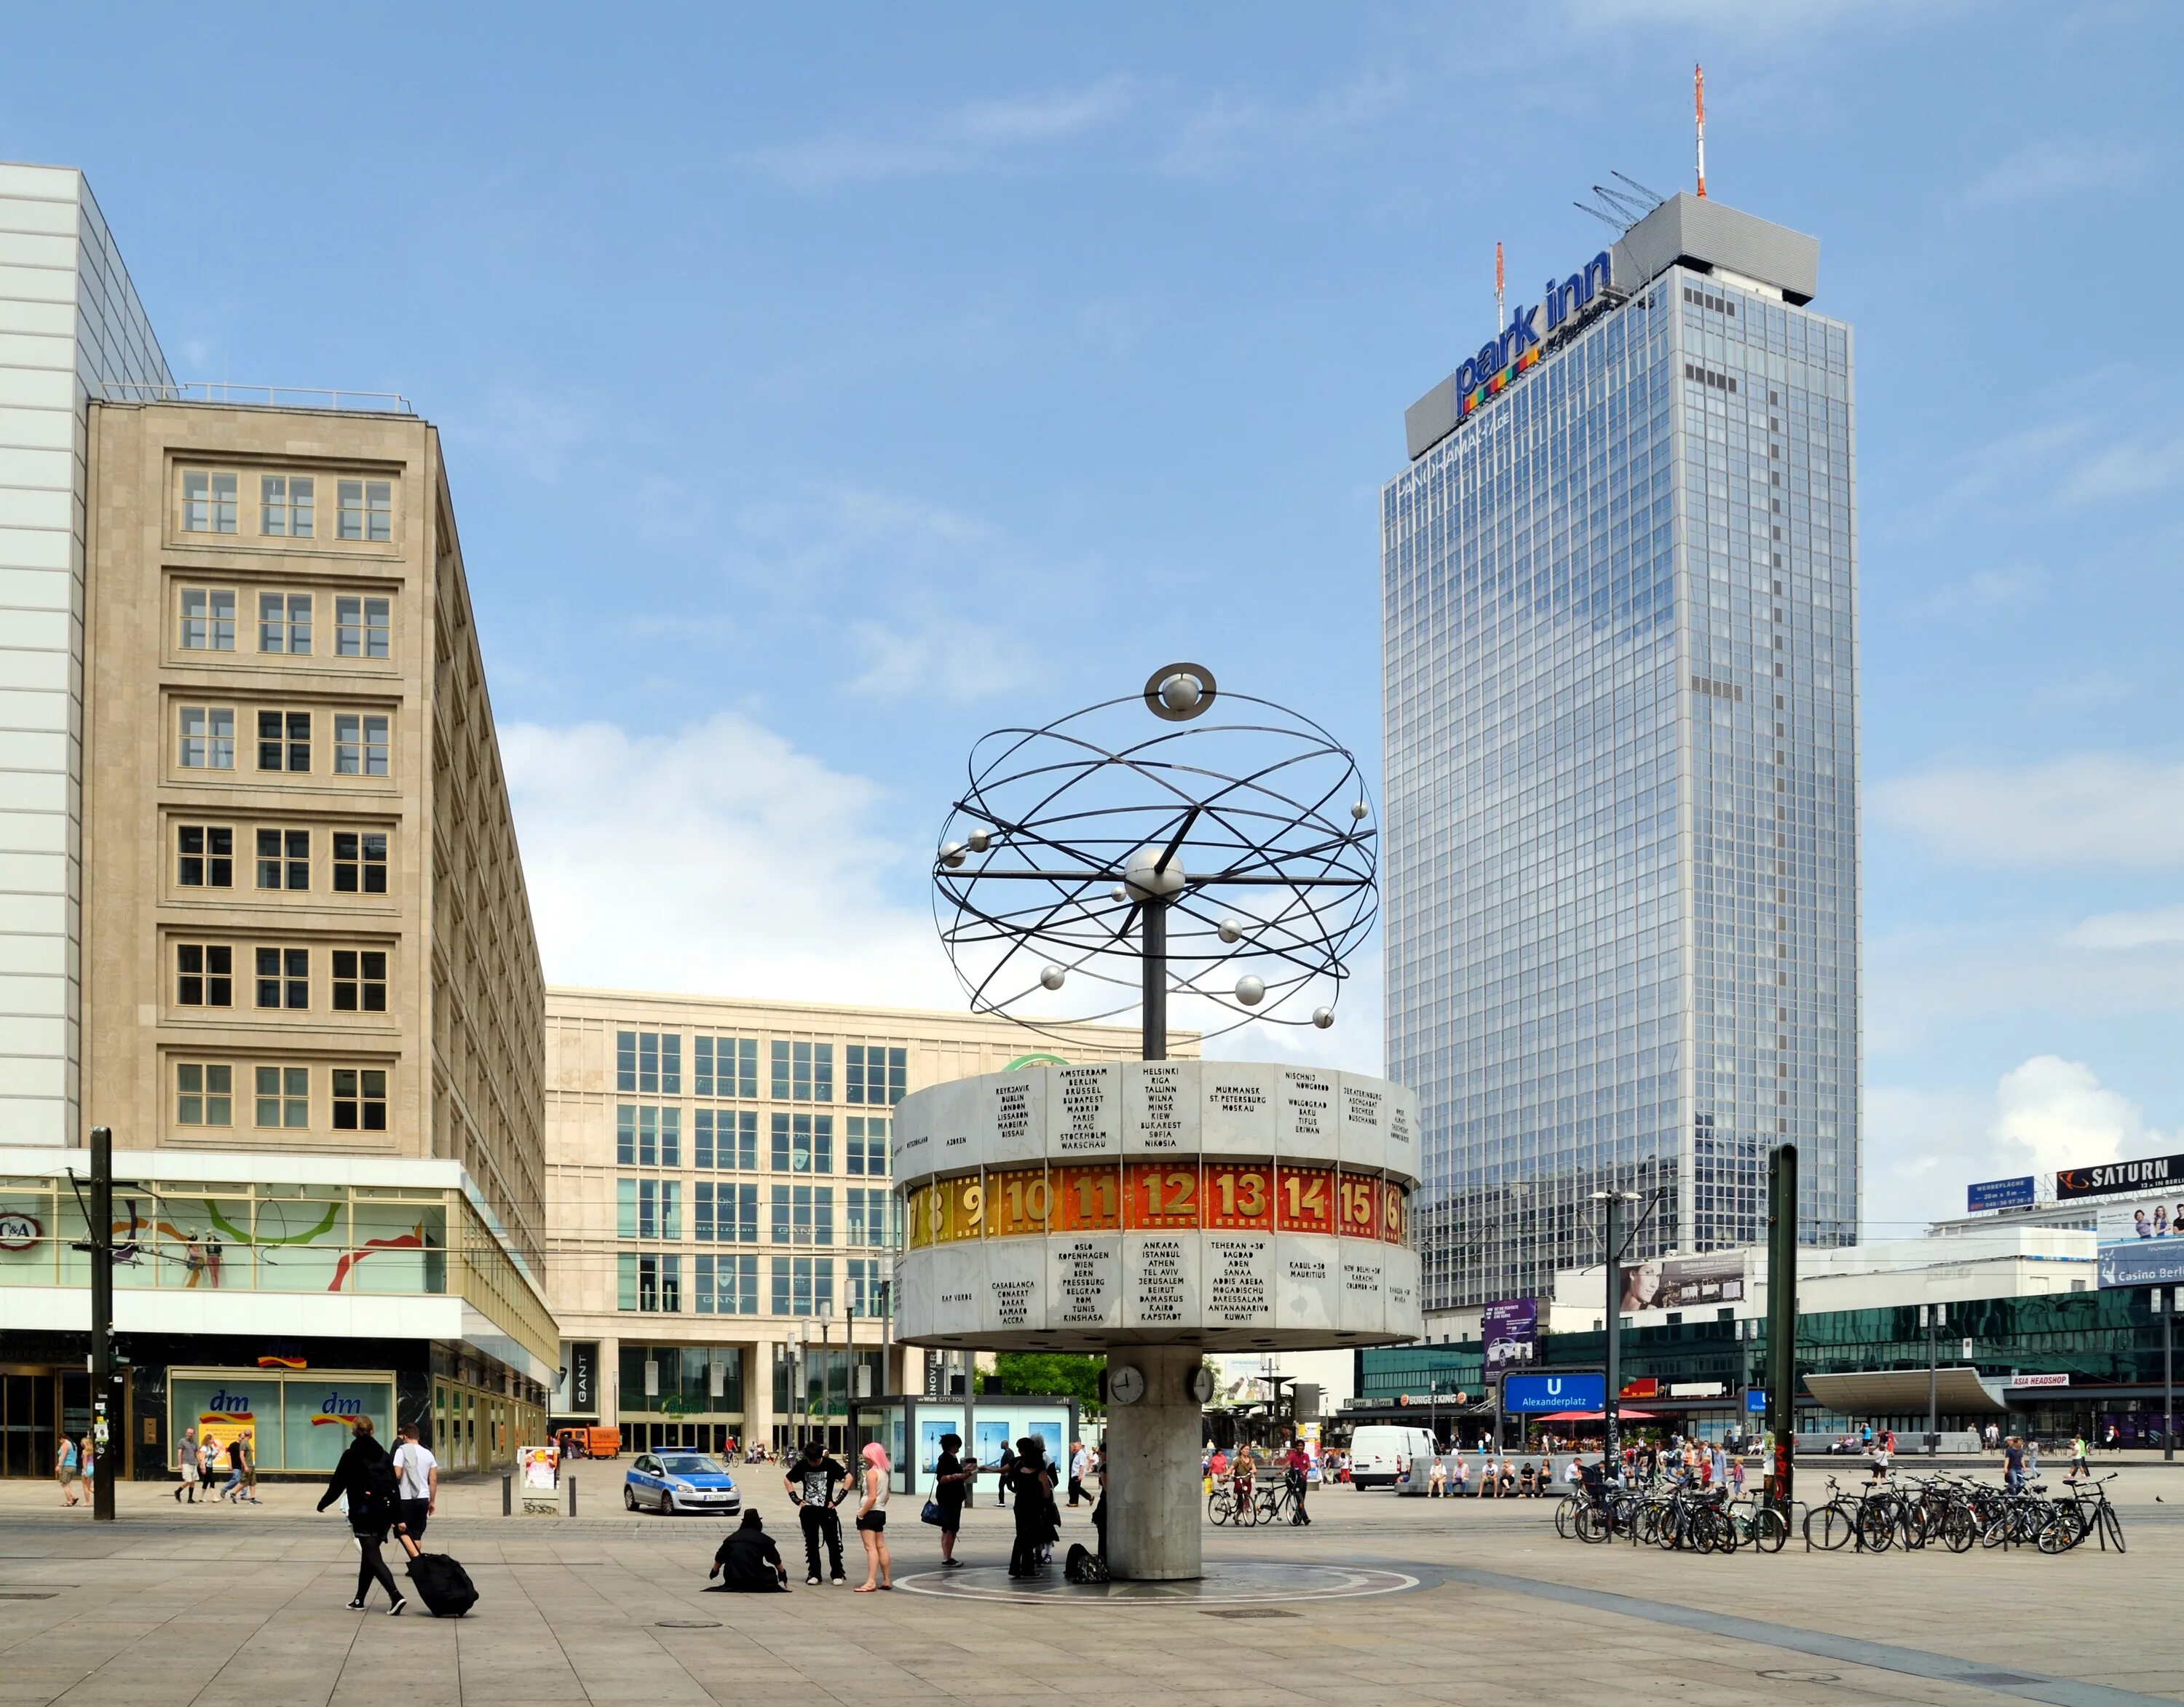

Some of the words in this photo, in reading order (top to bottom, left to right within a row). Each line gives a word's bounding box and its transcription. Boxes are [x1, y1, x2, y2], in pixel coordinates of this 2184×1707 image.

[1456, 305, 1540, 417] park
[1546, 251, 1610, 331] inn
[1060, 1069, 1107, 1077] AMSTERDAM
[1286, 1072, 1315, 1082] NISCHNIJ
[1069, 1078, 1097, 1086] BERLIN
[1296, 1082, 1329, 1091] NOWGOROD
[996, 1085, 1029, 1095] REYKJAVIK
[1066, 1087, 1101, 1095] BRÜSSEL
[1216, 1086, 1259, 1095] MURMANSK
[1002, 1094, 1024, 1103] DUBLIN
[1063, 1096, 1104, 1104] BUDAPEST
[1221, 1096, 1266, 1104] PETERSBURG
[1349, 1096, 1377, 1107] ASCHGABAT
[1000, 1103, 1025, 1112] LONDON
[1222, 1104, 1254, 1112] MOSKAU
[1289, 1099, 1326, 1109] WOLGOGRAD
[1067, 1105, 1099, 1113] MADRID
[1299, 1109, 1315, 1117] BAKU
[997, 1111, 1028, 1121] LISSABON
[1073, 1114, 1094, 1122] PARIS
[1348, 1114, 1377, 1125] DUSCHANBE
[997, 1120, 1028, 1130] MADEIRA
[1299, 1117, 1317, 1125] TIFLIS
[1073, 1122, 1093, 1130] PRAG
[1296, 1125, 1319, 1134] ERIWAN
[1002, 1129, 1024, 1138] BISSAU
[1060, 1131, 1107, 1141] STOCKHOLM
[946, 1137, 966, 1146] AZOREN
[1061, 1141, 1105, 1149] WARSCHAU
[2092, 1160, 2168, 1187] SATURN
[1977, 1180, 2025, 1191] WERBEFLÄCHE
[1074, 1175, 1114, 1216] 11
[1142, 1173, 1195, 1214] 12
[1216, 1173, 1265, 1216] 13
[1285, 1177, 1324, 1219] 14
[1006, 1179, 1054, 1221] 10
[1340, 1182, 1370, 1224] 15
[963, 1186, 986, 1226] 9
[927, 1192, 943, 1232] 8
[1059, 1252, 1109, 1260] KOPENHAGEN
[1289, 1262, 1310, 1270] KABUL
[1290, 1270, 1326, 1278] MAURITIUS
[1352, 1274, 1372, 1282] KARACHI
[2118, 1270, 2155, 1281] Casino
[992, 1281, 1034, 1290] CASABLANCA
[1063, 1278, 1104, 1286] PRESSBURG
[954, 1293, 972, 1301] VERDE
[997, 1290, 1029, 1298] CONAKRY
[1002, 1299, 1024, 1307] DAKAR
[999, 1307, 1027, 1316] BAMAKO
[1064, 1314, 1104, 1322] KINSHASA
[2030, 1377, 2066, 1385] HEADSHOP
[1548, 1379, 1561, 1395] U
[210, 1390, 248, 1411] dm
[322, 1392, 360, 1414] dm
[1438, 1395, 1456, 1403] KING
[1522, 1398, 1586, 1407] Alexanderplatz
